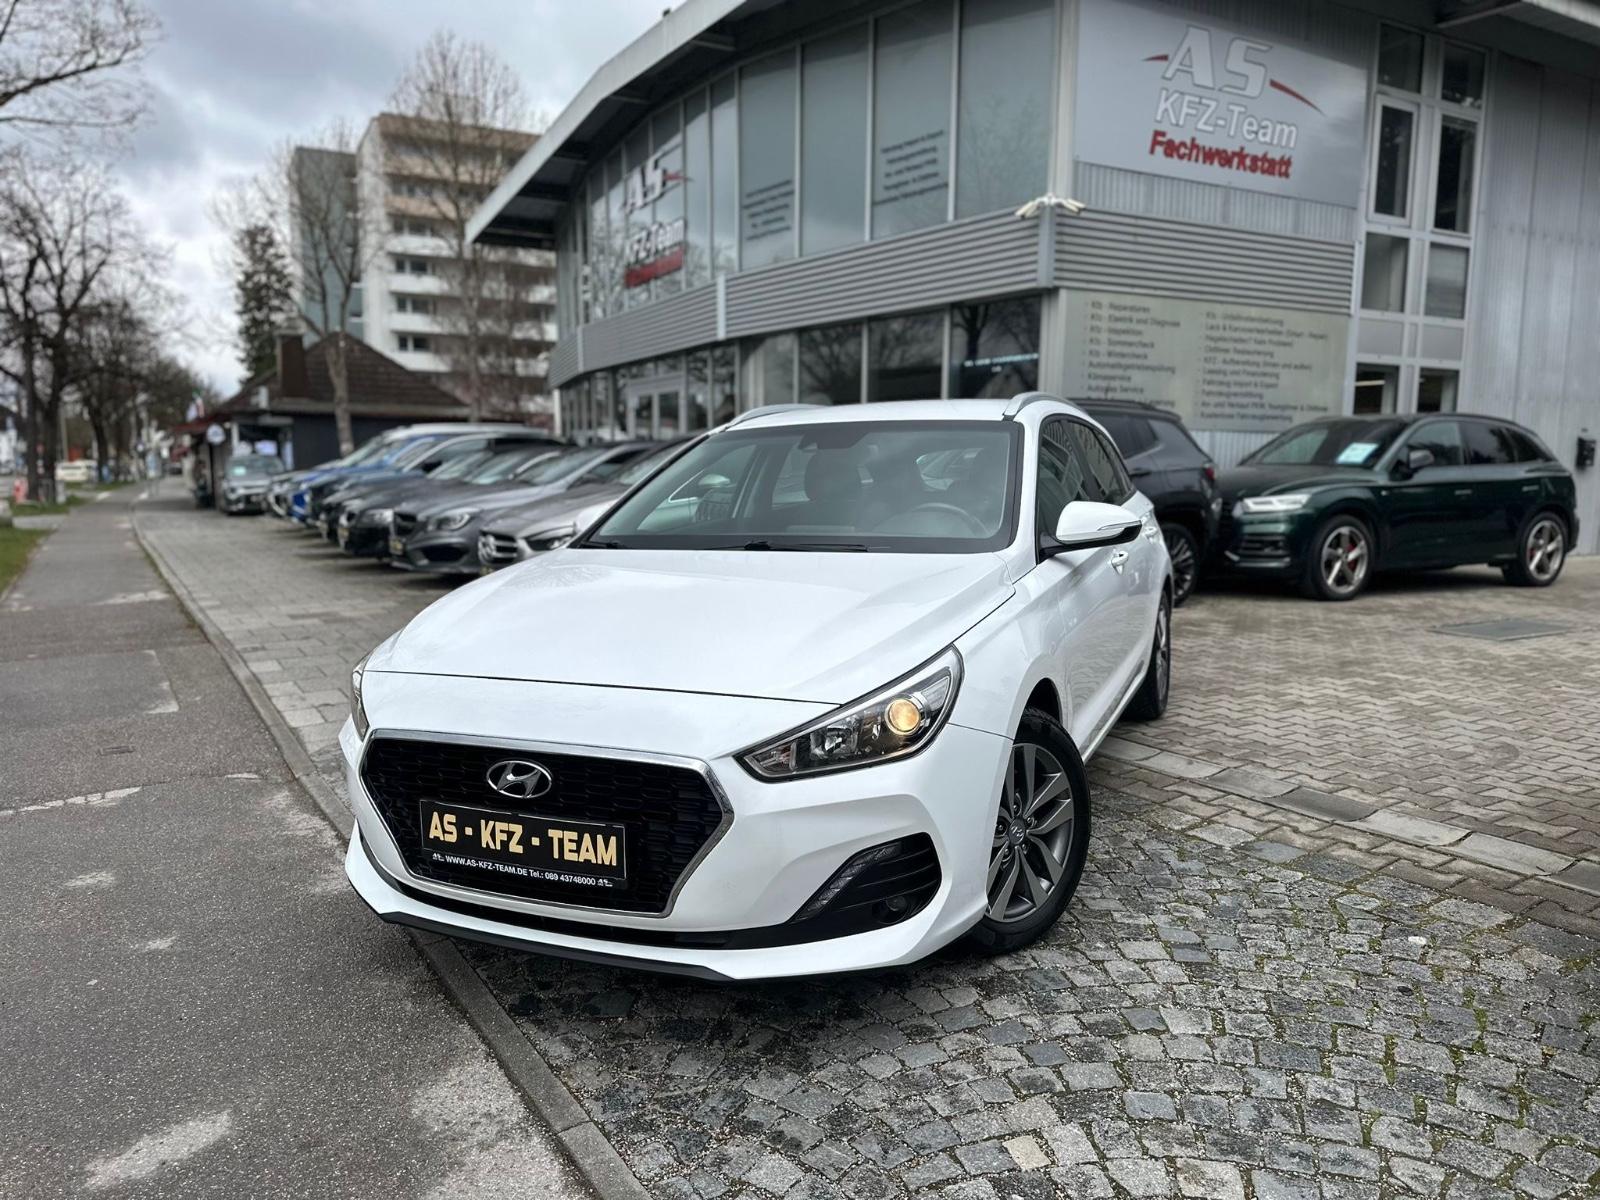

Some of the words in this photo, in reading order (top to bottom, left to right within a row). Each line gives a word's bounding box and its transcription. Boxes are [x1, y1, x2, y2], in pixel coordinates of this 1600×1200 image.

[1161, 24, 1273, 99] AS
[1155, 87, 1298, 148] KFZ-Team
[1149, 129, 1292, 179] Fachwerkstatt
[429, 811, 458, 843] AS
[480, 819, 523, 854] KFZ
[548, 829, 617, 867] TEAM
[445, 855, 528, 876] WWW.AS-KFZ-TEAM.DE
[544, 872, 559, 881] 089
[560, 874, 596, 886] 43748000
